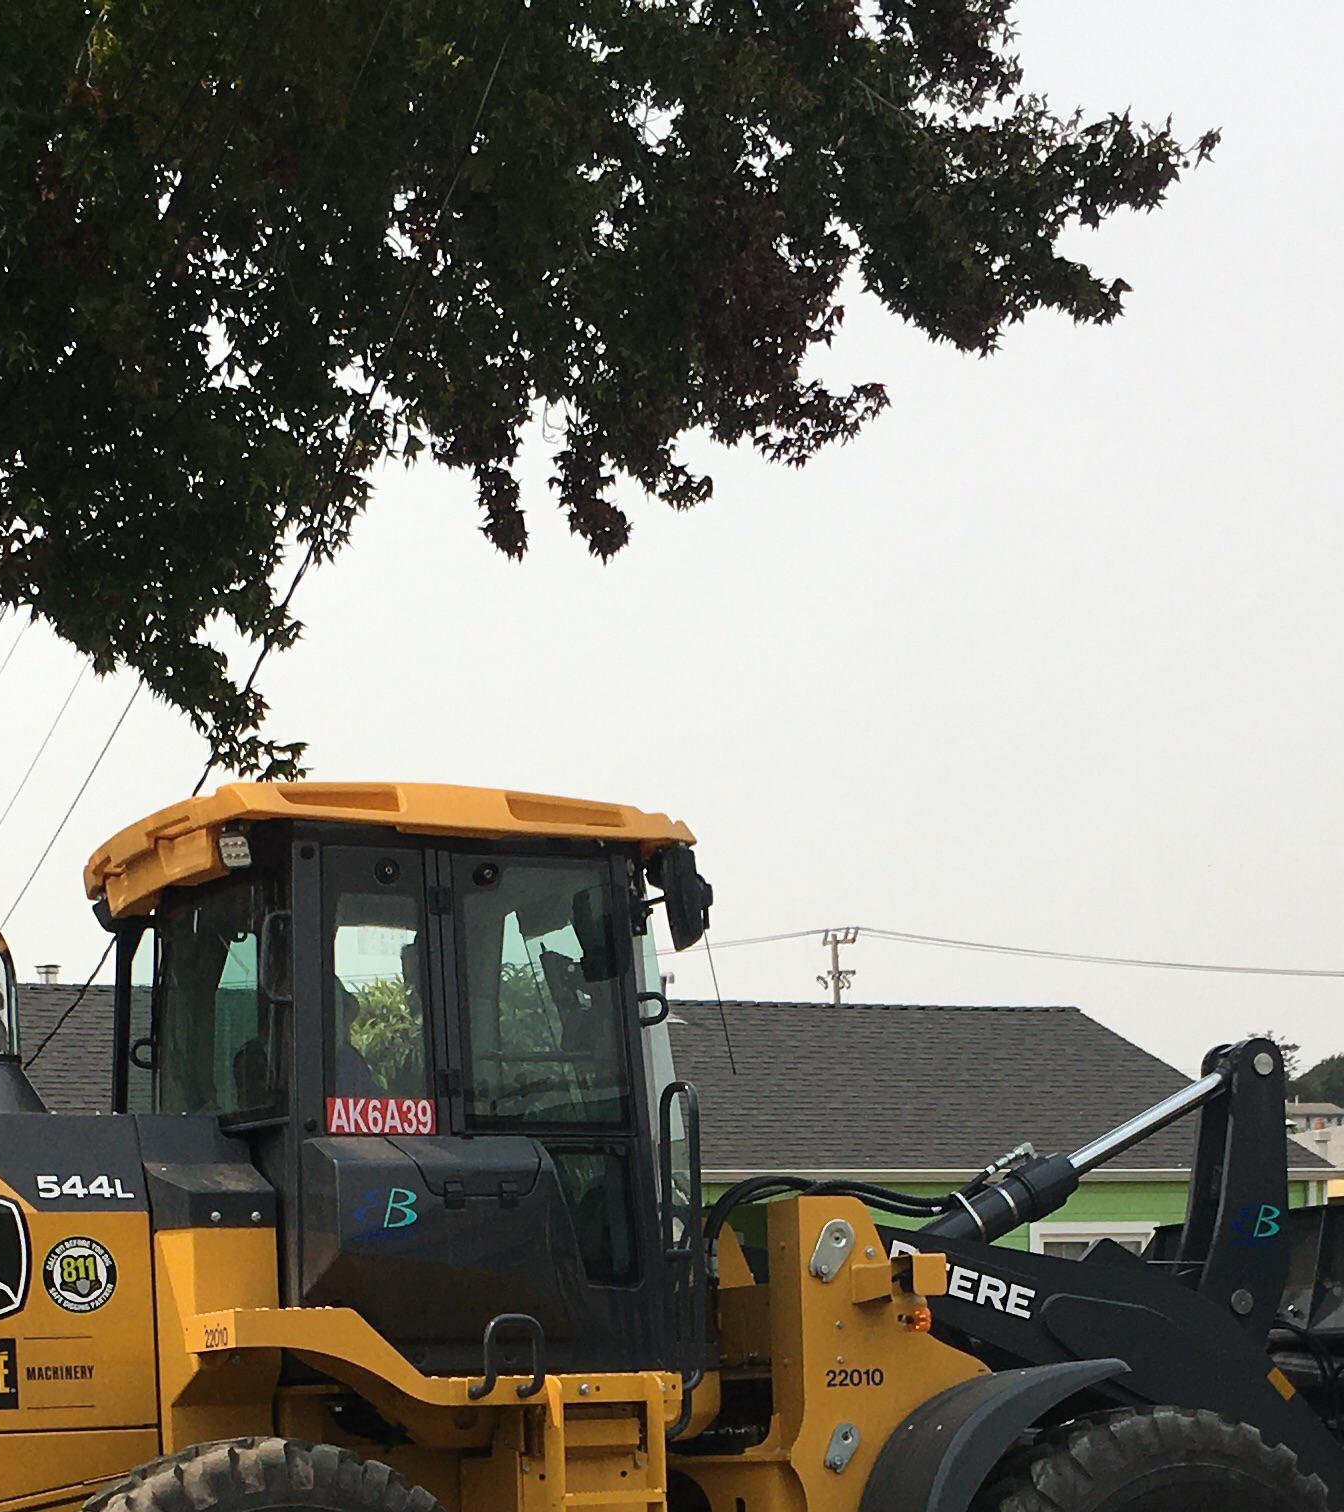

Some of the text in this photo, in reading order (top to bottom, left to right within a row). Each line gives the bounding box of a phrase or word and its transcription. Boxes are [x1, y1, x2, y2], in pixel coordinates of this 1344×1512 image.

[330, 1098, 432, 1134] AK6A39
[37, 1176, 134, 1198] 544L
[61, 1256, 97, 1282] 811
[889, 1240, 1035, 1319] ERE
[26, 1365, 95, 1381] MACHINERY
[826, 1368, 884, 1387] 22010
